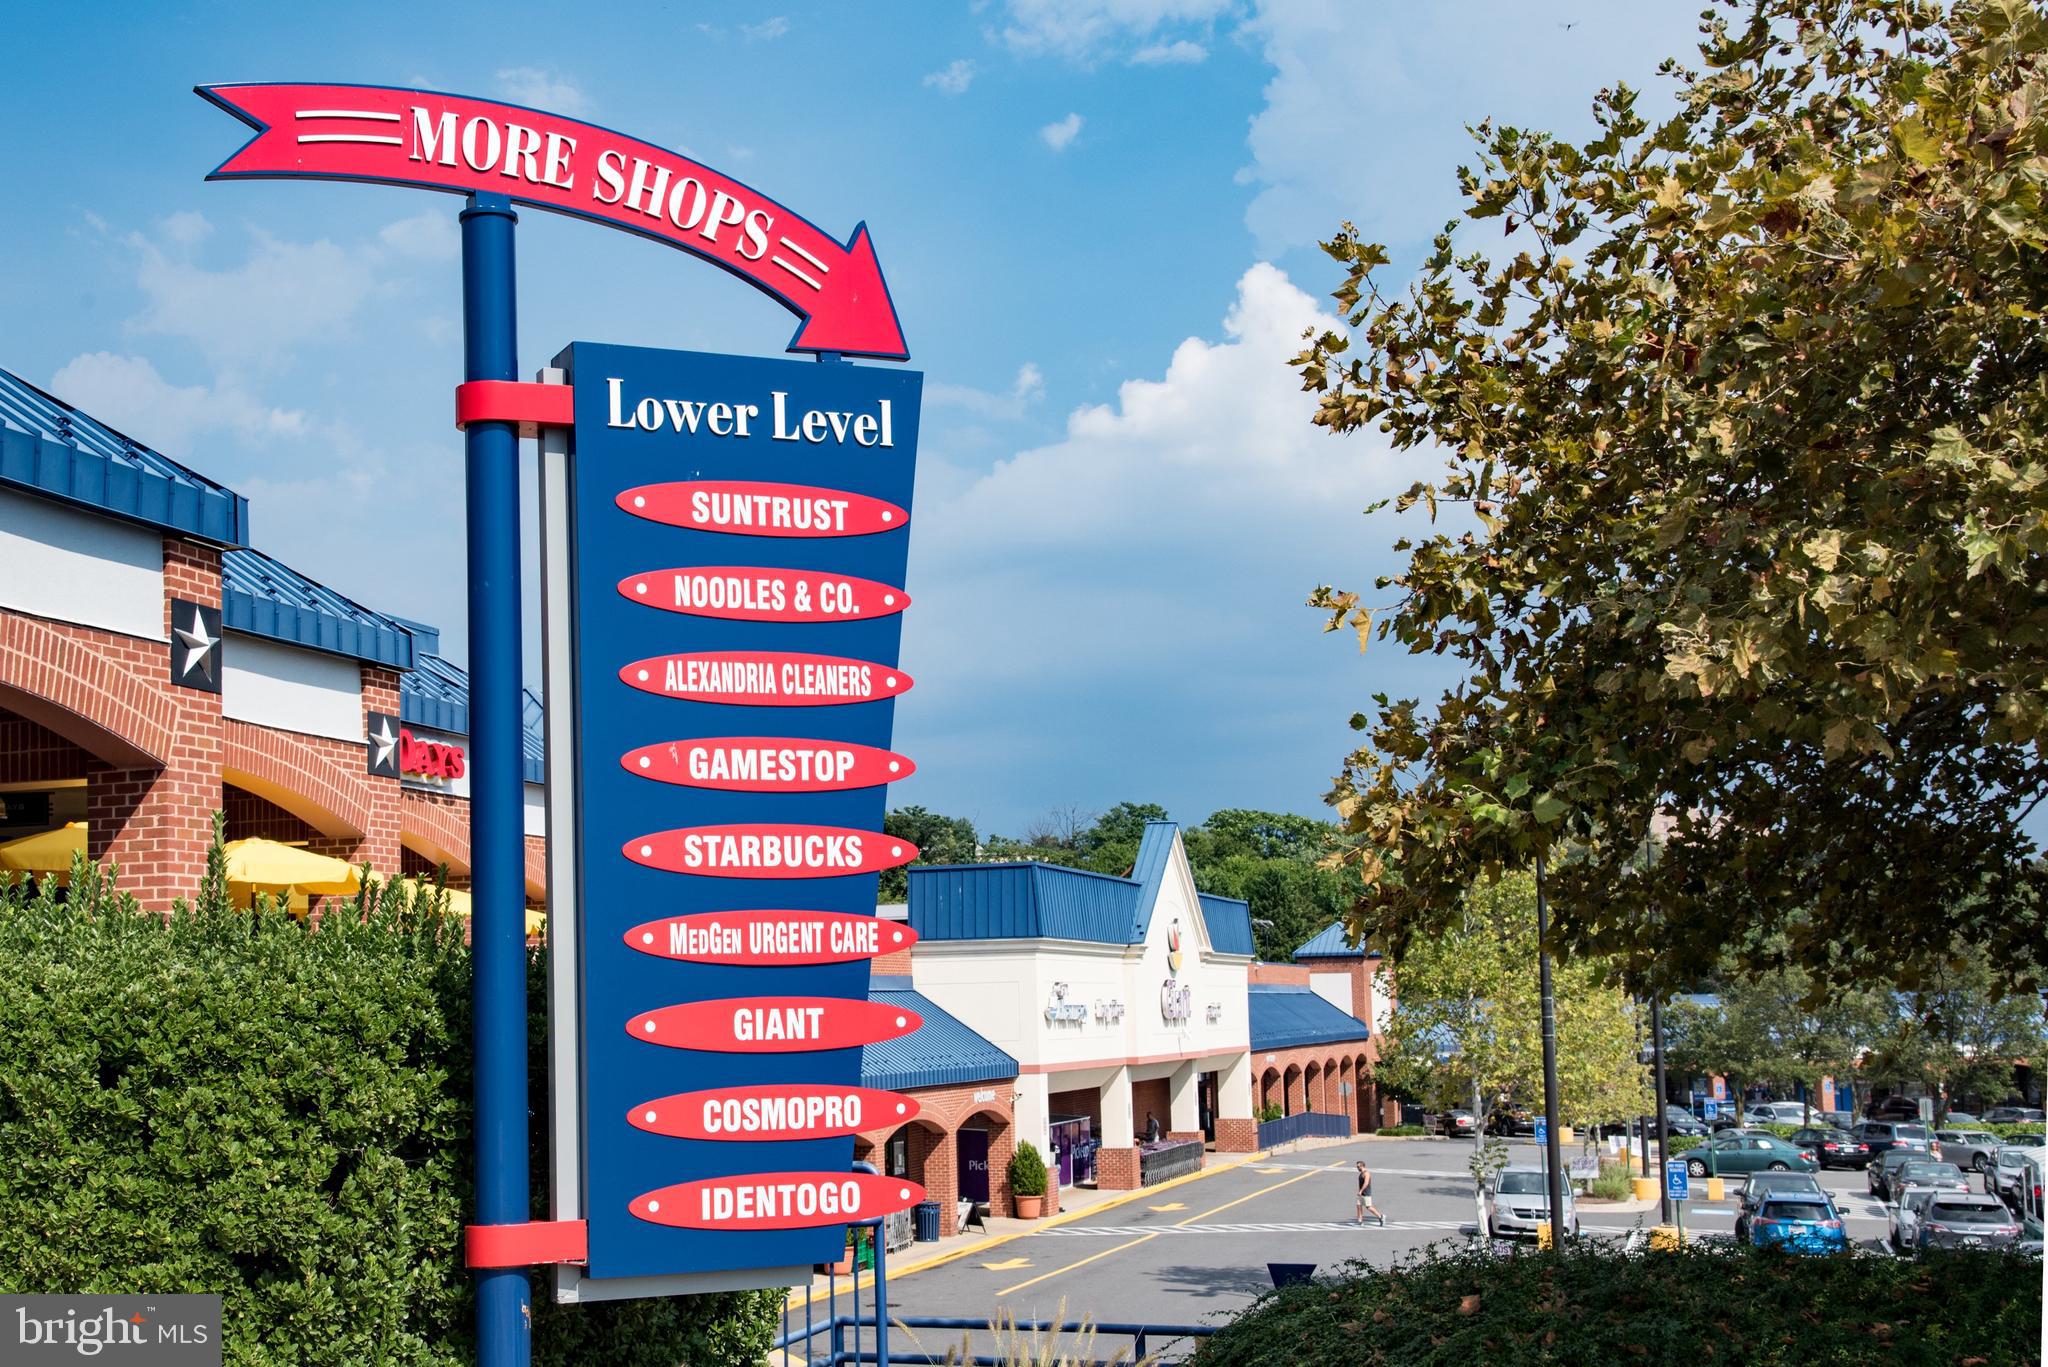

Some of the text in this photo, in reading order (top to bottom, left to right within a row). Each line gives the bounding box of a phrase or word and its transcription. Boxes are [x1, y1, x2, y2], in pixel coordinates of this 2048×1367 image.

[410, 106, 774, 260] MORE SHOPS
[607, 378, 894, 446] Lower Level
[691, 491, 849, 531] SUNTRUST
[674, 575, 860, 614] NOODLES & CO.
[665, 660, 872, 697] ALEXANDRIA CLEANERS
[689, 747, 855, 782] GAMESTOP
[684, 834, 863, 868] STARBUCKS
[749, 921, 825, 954] URGENT
[830, 921, 879, 954] CARE
[733, 1007, 824, 1041] GIANT
[703, 1094, 862, 1133] COSMOPRO
[701, 1181, 861, 1221] IDENTOGO
